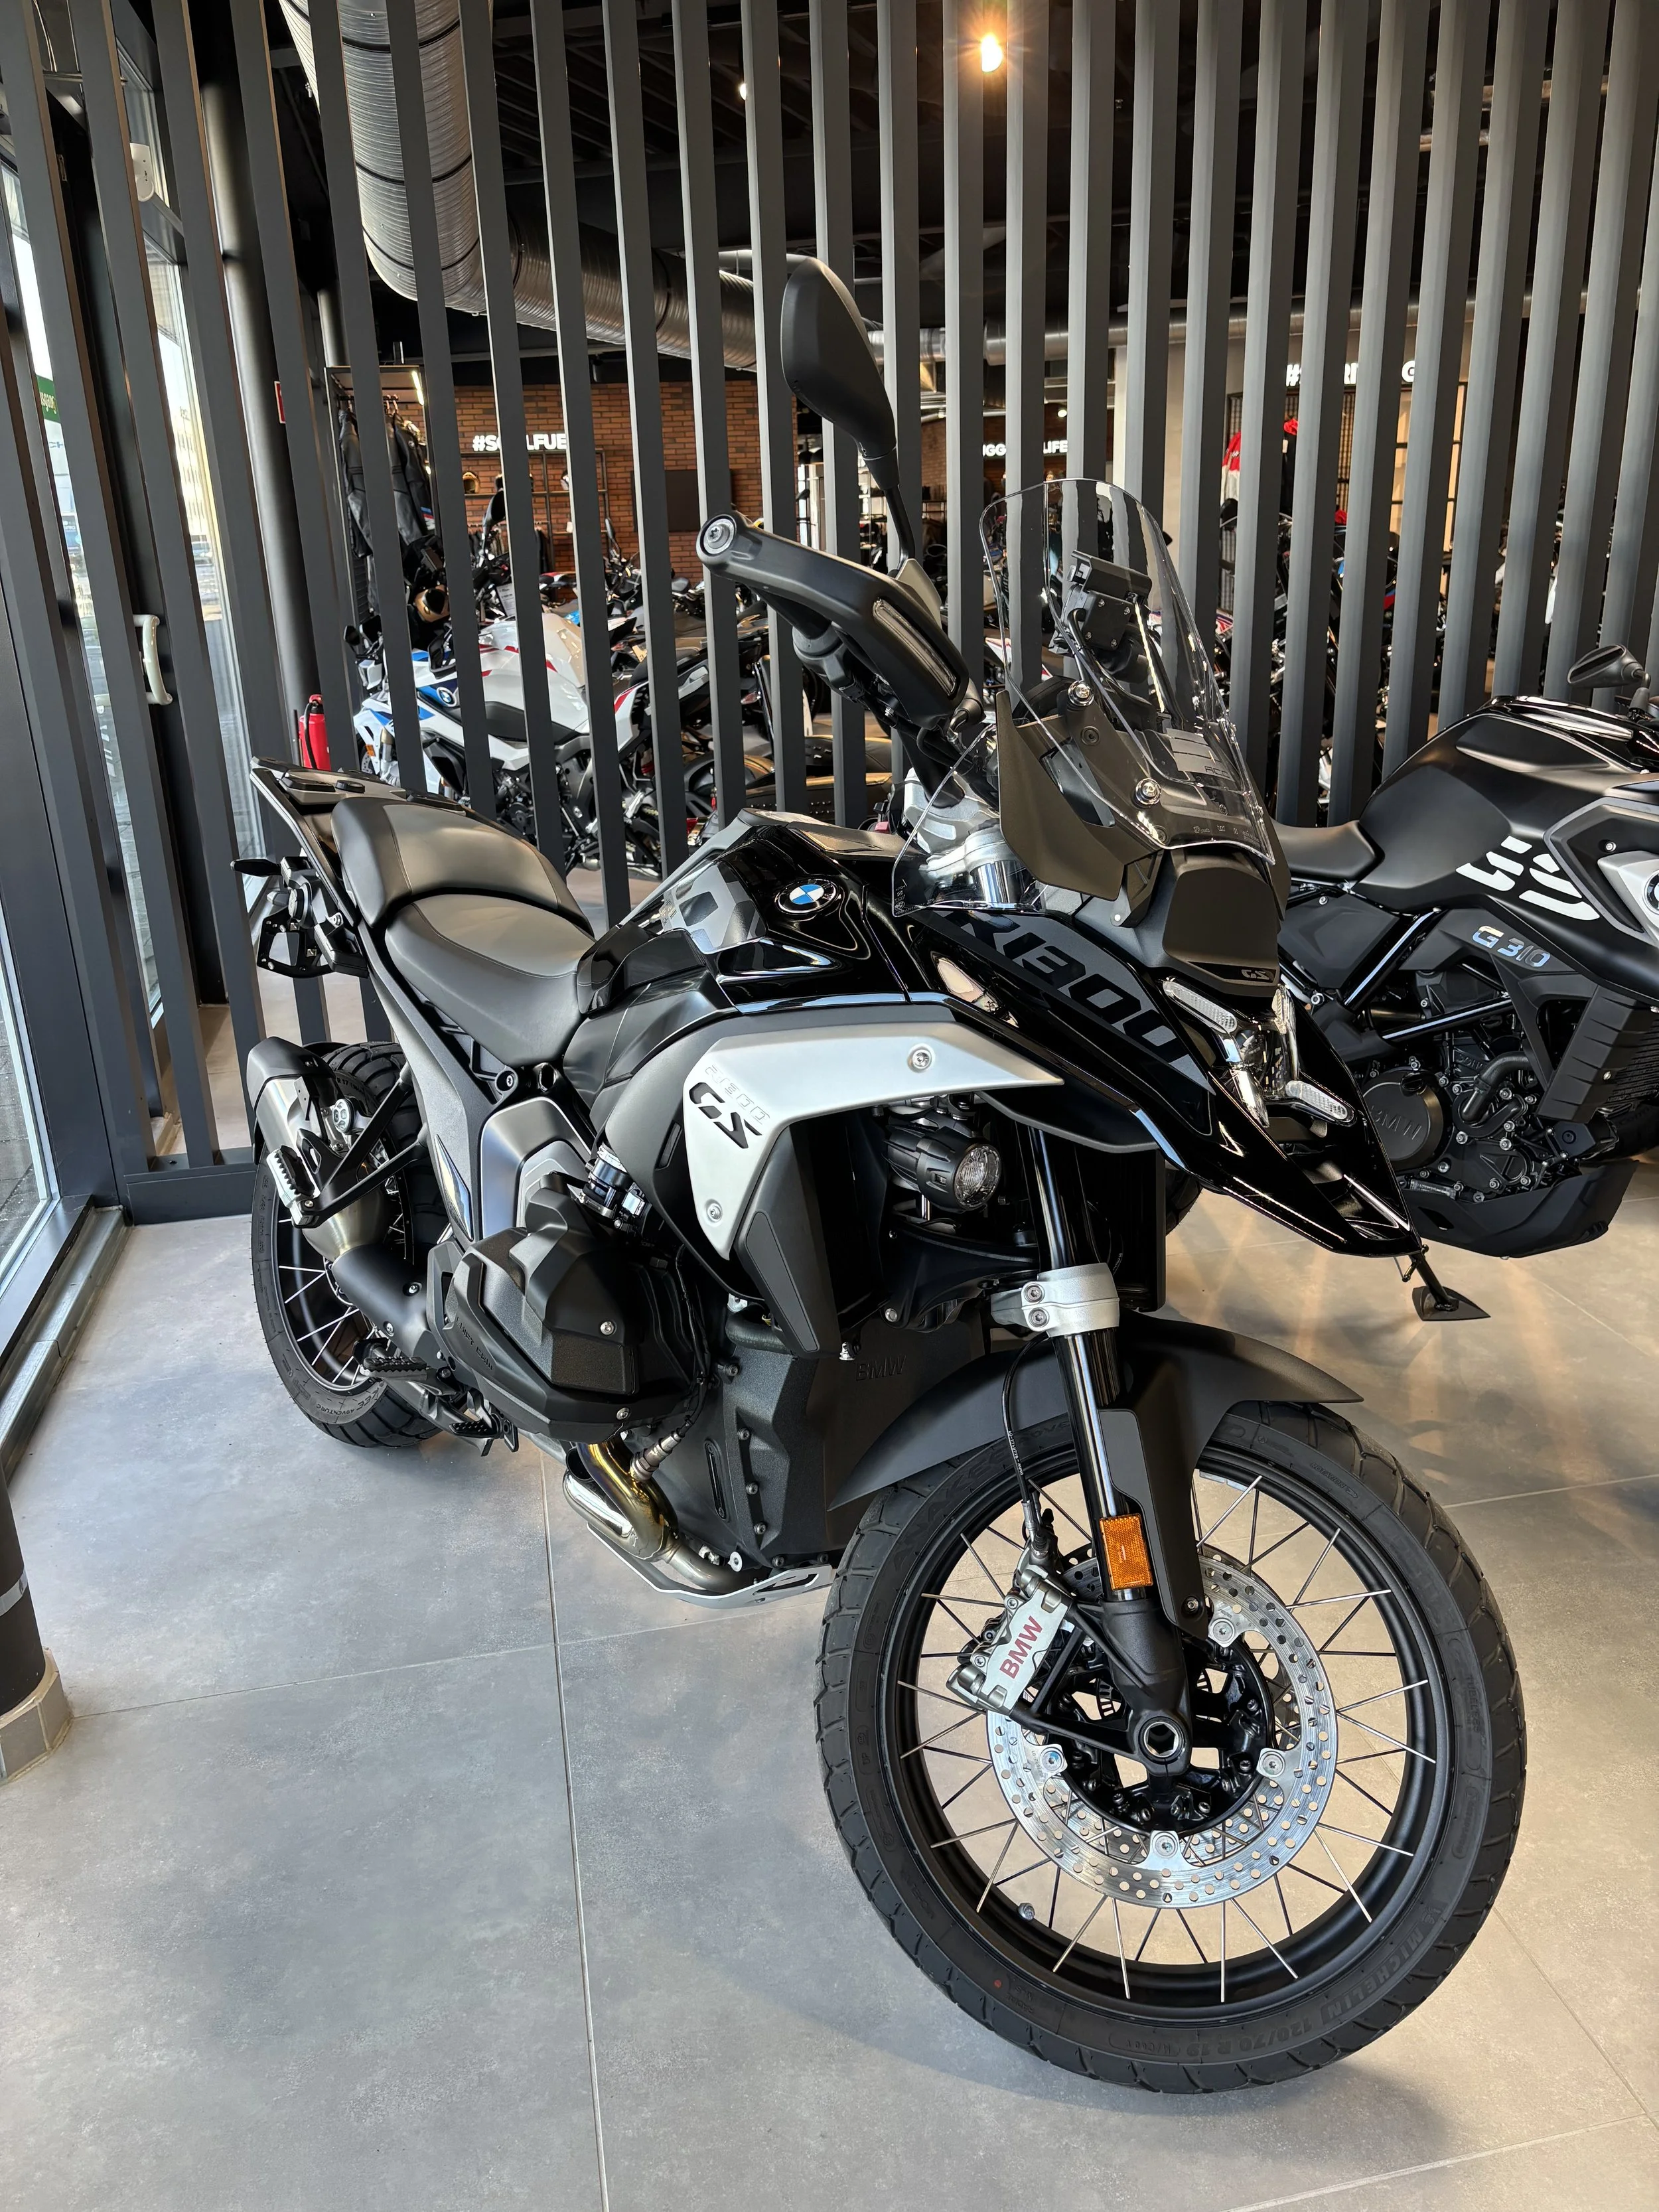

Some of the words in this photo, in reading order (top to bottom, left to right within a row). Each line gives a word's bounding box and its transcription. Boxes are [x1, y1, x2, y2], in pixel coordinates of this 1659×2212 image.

[1472, 925, 1505, 949] G
[1497, 937, 1551, 968] 310
[1241, 969, 1270, 980] GS
[689, 1082, 762, 1149] GS
[855, 1355, 907, 1382] BMW
[315, 1403, 356, 1416] ADVENTURE
[999, 1615, 1043, 1679] BMW
[1329, 1930, 1425, 2016] MICHELIN
[1186, 2041, 1211, 2057] 19
[1216, 2040, 1232, 2056] R
[1240, 2018, 1313, 2051] 120/70
